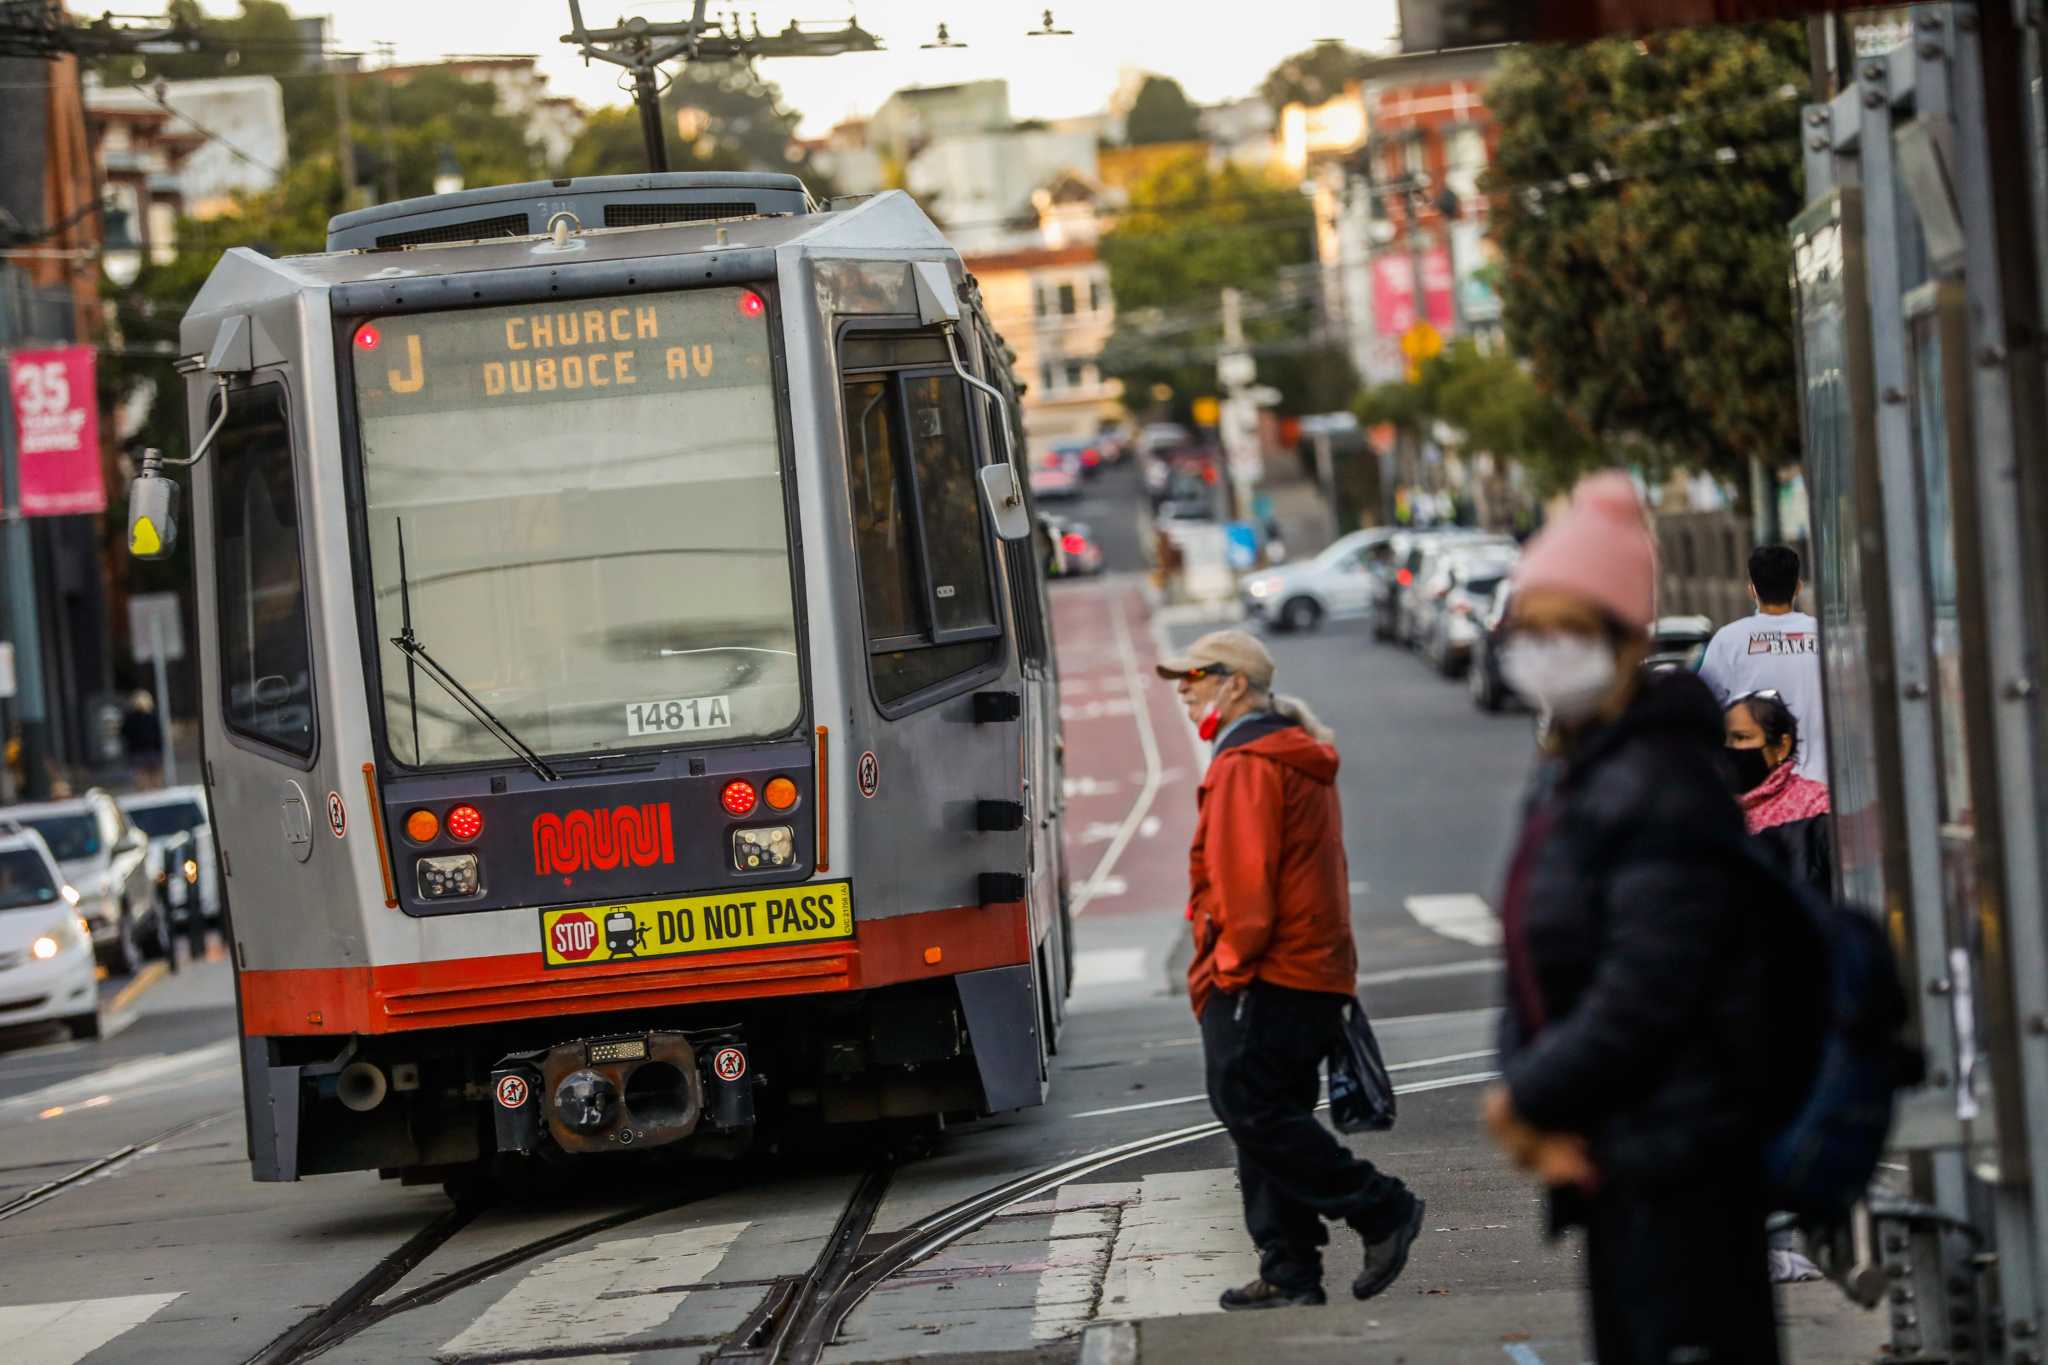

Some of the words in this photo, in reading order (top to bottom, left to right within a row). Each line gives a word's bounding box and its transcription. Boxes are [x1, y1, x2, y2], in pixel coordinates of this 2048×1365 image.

[505, 305, 658, 351] CHURCH
[15, 361, 71, 416] 35
[388, 334, 425, 393] J
[484, 350, 637, 396] DUBOCE
[665, 344, 713, 381] AV
[532, 802, 676, 876] MUNI
[555, 920, 596, 953] STOP
[657, 908, 695, 945] DO
[704, 902, 757, 941] NOT
[766, 894, 835, 934] PASS
